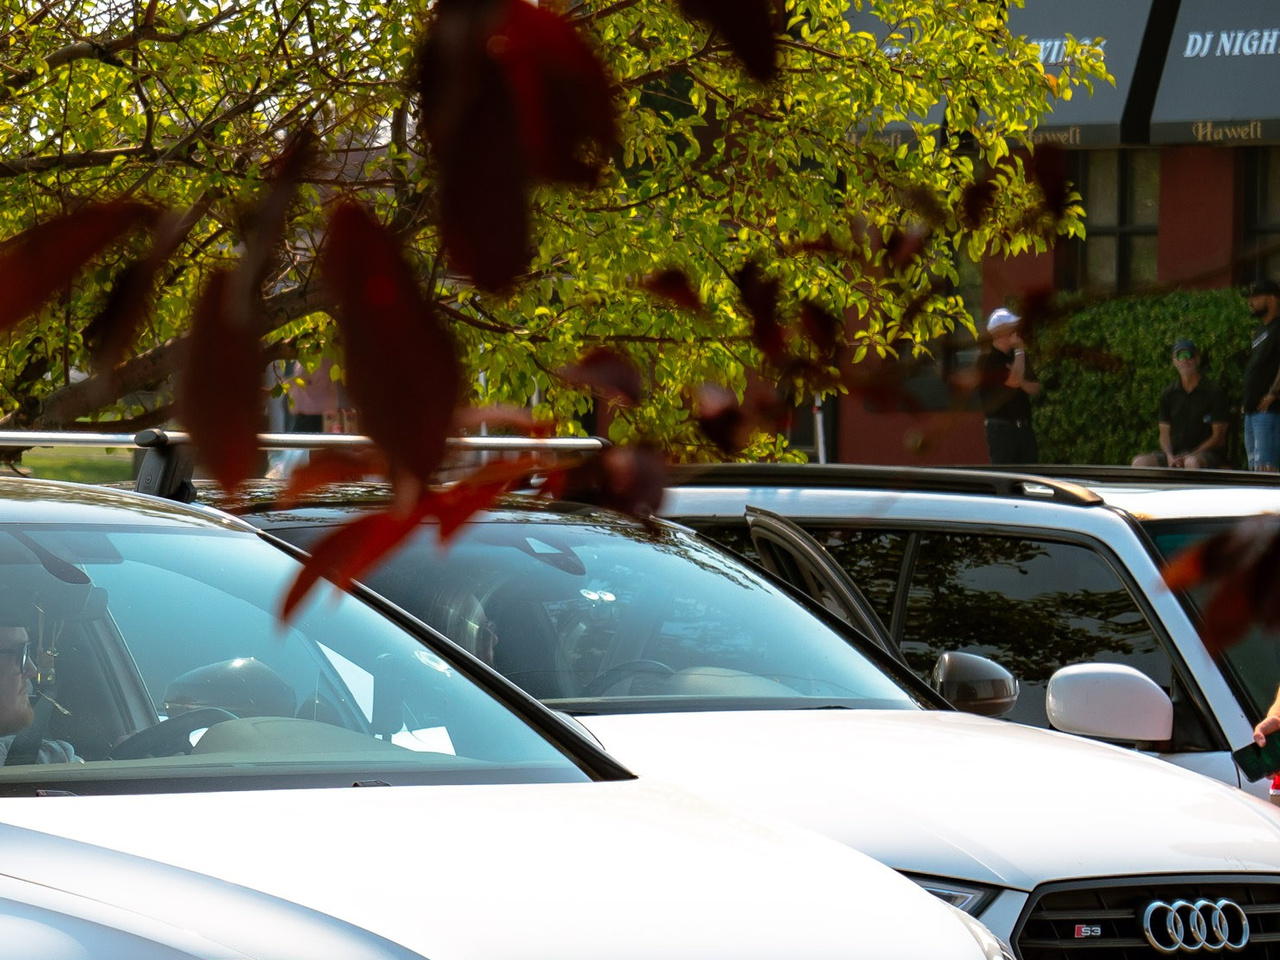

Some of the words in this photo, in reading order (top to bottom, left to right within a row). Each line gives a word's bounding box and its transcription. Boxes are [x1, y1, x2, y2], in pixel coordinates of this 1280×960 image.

[1183, 32, 1213, 58] DJ
[1215, 28, 1280, 57] NIGH
[1081, 926, 1101, 936] S3
